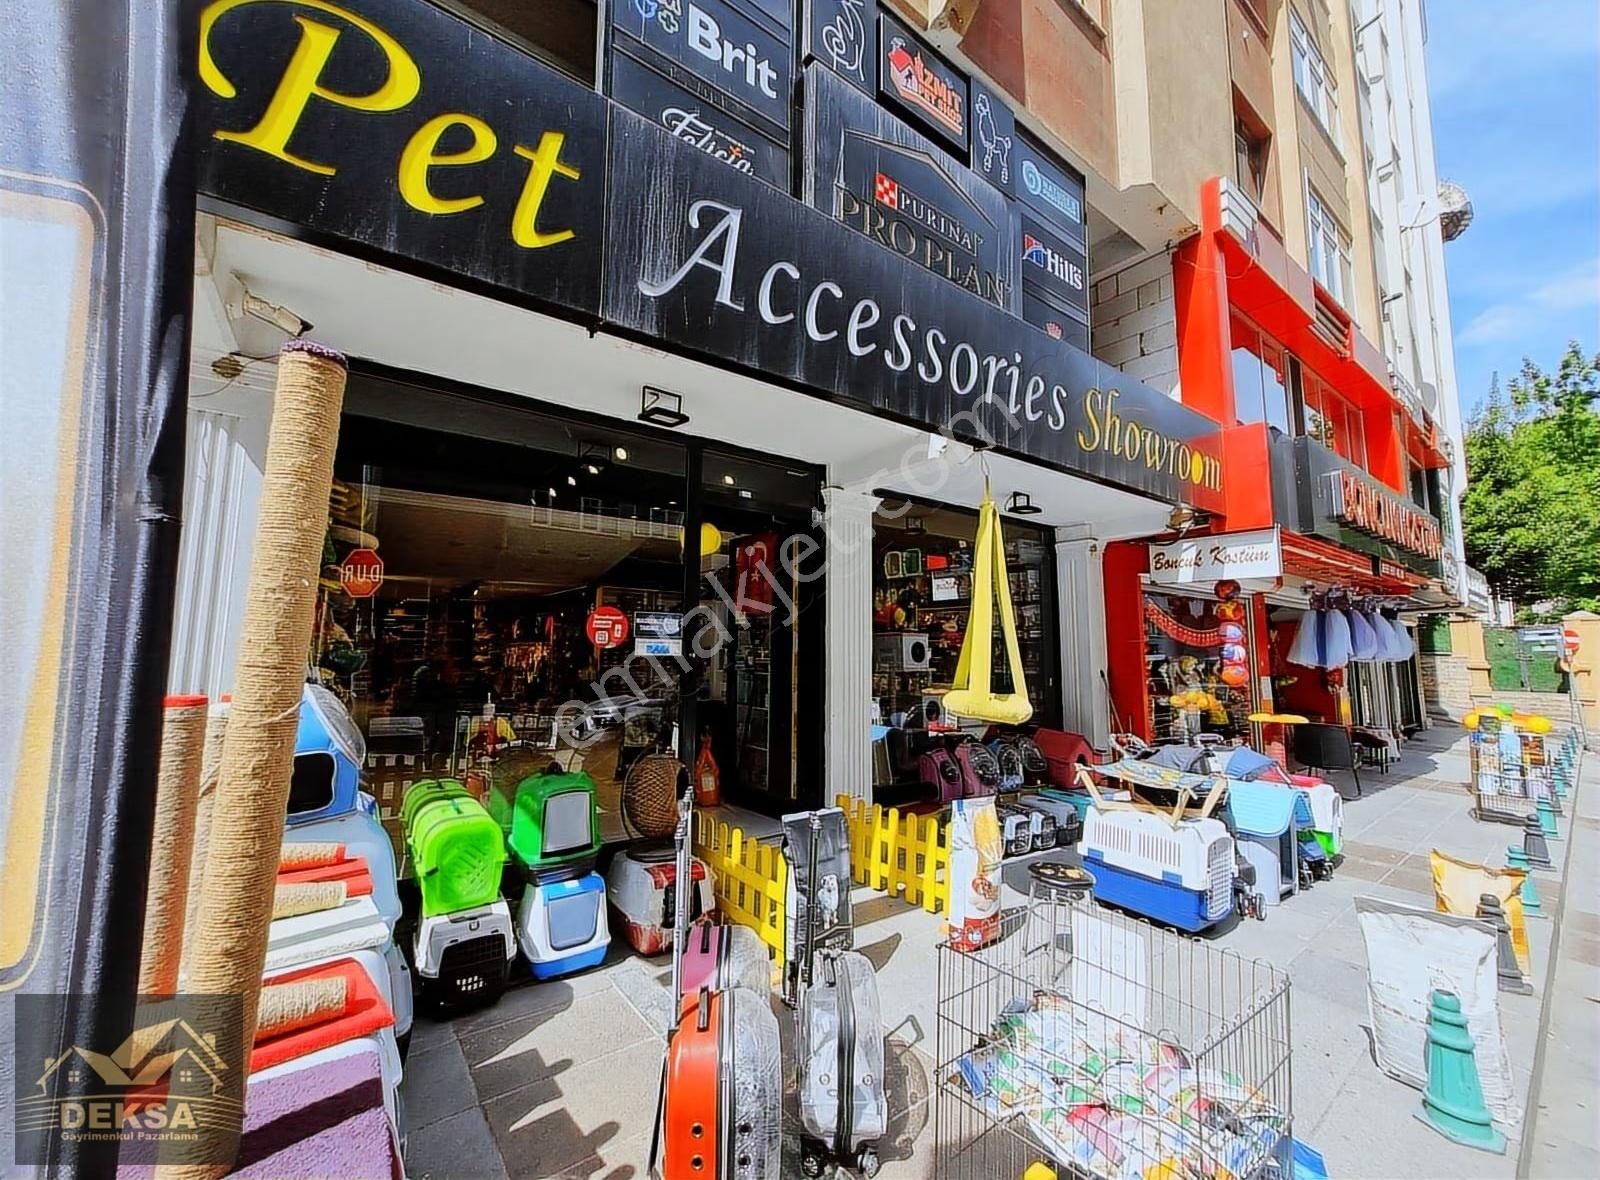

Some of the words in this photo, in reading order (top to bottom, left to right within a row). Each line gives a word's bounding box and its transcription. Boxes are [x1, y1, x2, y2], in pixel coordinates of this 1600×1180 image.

[688, 3, 777, 99] Brit
[198, 0, 580, 249] Pet
[638, 200, 1067, 431] Accessories
[1077, 388, 1222, 493] Showroom
[835, 185, 916, 256] PRO
[923, 235, 1004, 307] PLAN
[901, 191, 973, 250] PURINA
[1153, 549, 1204, 571] Boncuk
[1210, 546, 1270, 566] Kostüm
